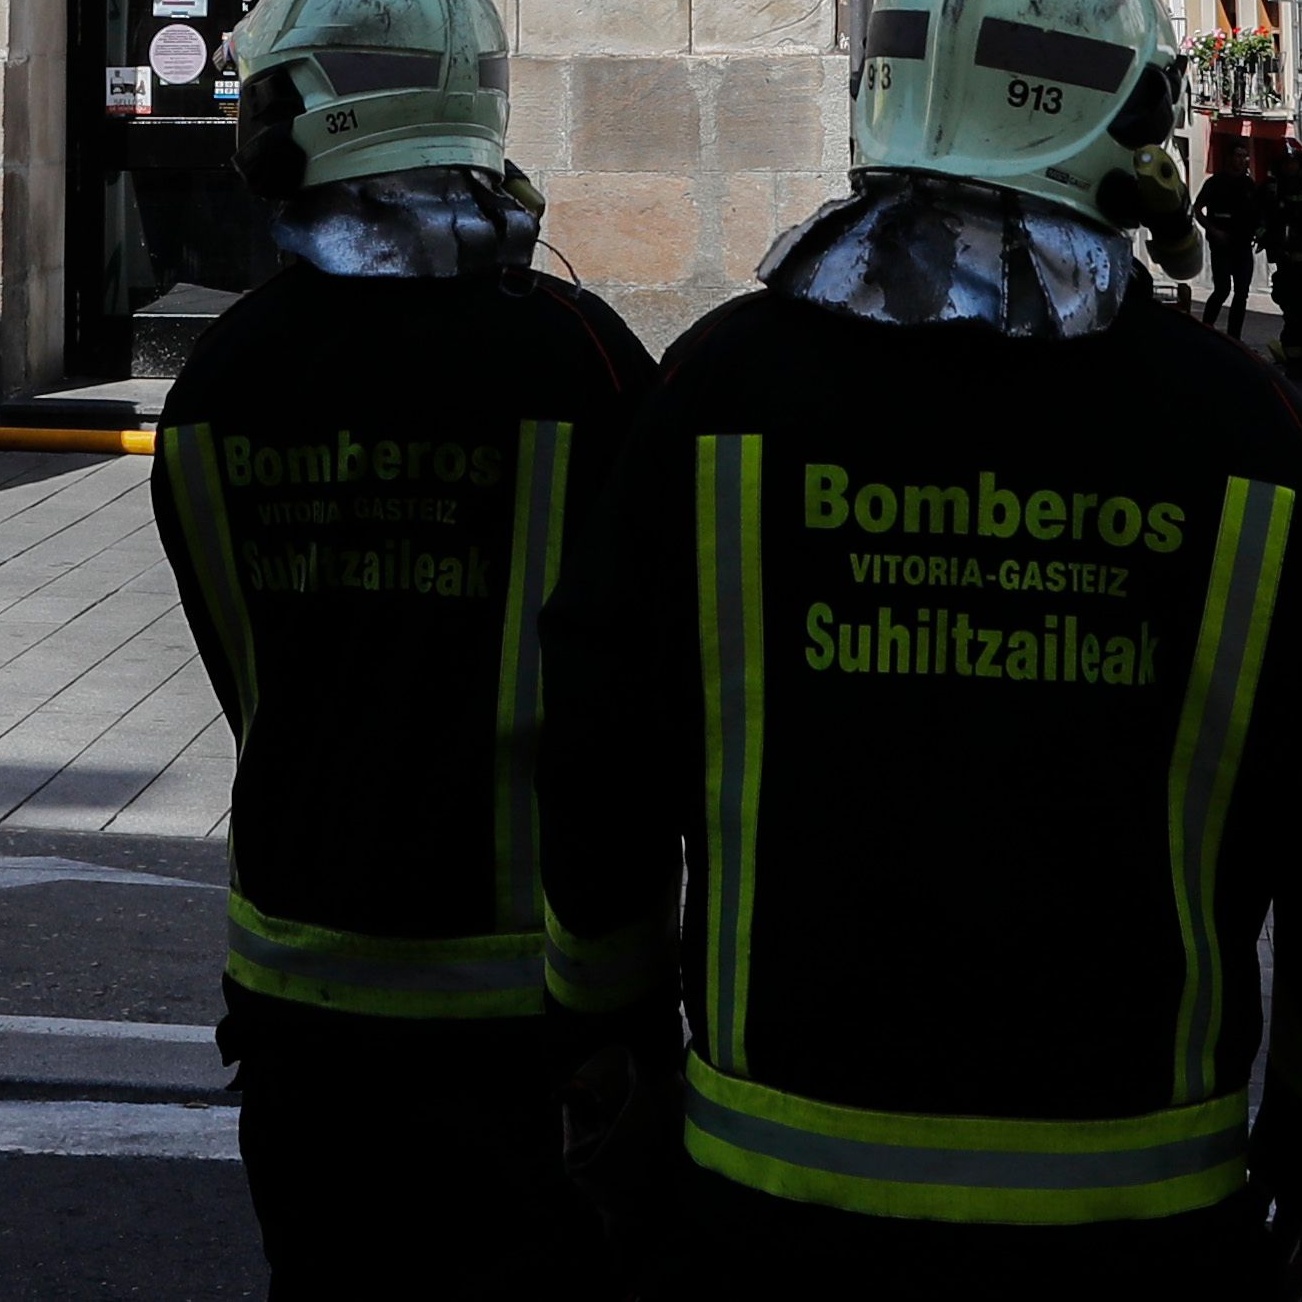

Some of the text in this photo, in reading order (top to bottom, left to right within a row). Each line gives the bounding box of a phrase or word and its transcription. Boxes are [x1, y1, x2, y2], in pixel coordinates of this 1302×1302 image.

[867, 63, 892, 91] 93
[1007, 79, 1062, 114] 913
[326, 108, 359, 135] 321
[222, 428, 504, 488] Bomberos
[805, 463, 1186, 554] Bomberos
[850, 553, 1129, 597] VITORIA-GASTEIZ
[805, 601, 1160, 685] Suhiltzaileak
